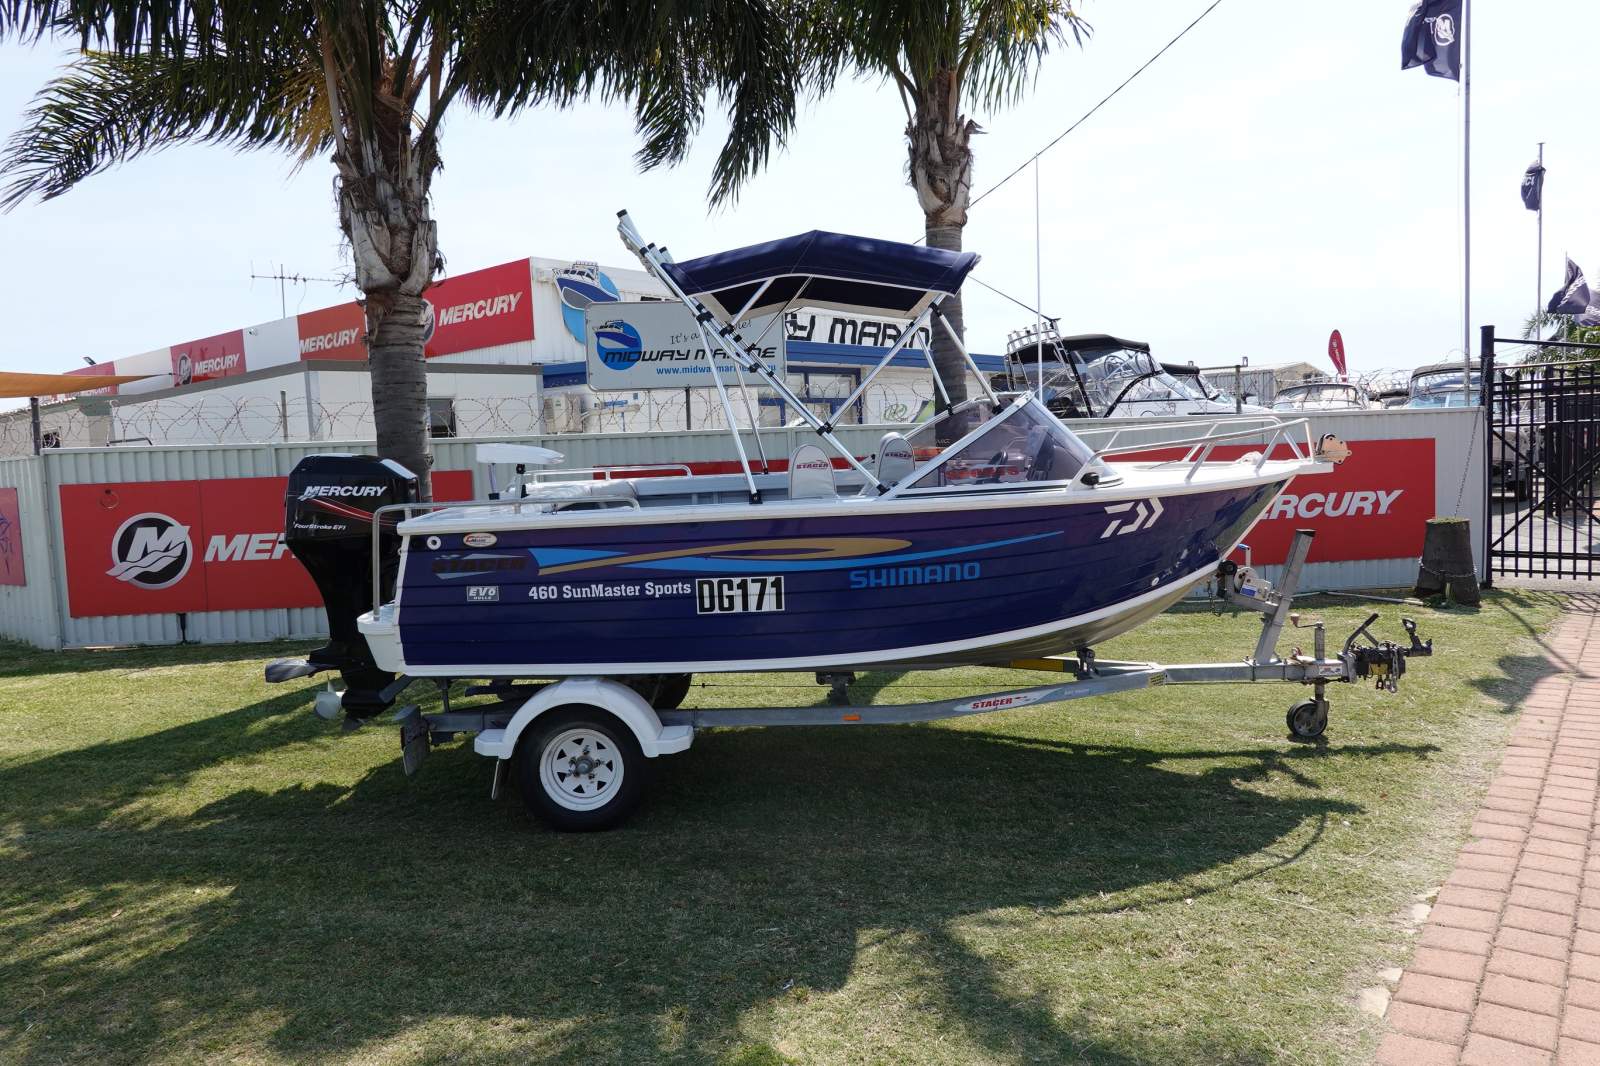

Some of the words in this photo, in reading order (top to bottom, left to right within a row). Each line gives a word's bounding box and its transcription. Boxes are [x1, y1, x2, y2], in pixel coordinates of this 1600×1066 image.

[438, 291, 523, 327] MERCURY
[299, 327, 359, 354] MERCURY
[828, 317, 930, 350] MARN
[194, 352, 240, 376] MERCURY
[604, 349, 691, 363] MIDWAY
[694, 346, 777, 361] MANE
[300, 485, 388, 499] MERCURY
[1261, 489, 1404, 520] RCURY
[849, 561, 980, 589] SHIMANO
[528, 585, 558, 600] 460
[562, 582, 641, 599] SunMaster
[644, 581, 692, 598] Sports
[697, 575, 784, 614] DG171
[971, 697, 1013, 710] STACER
